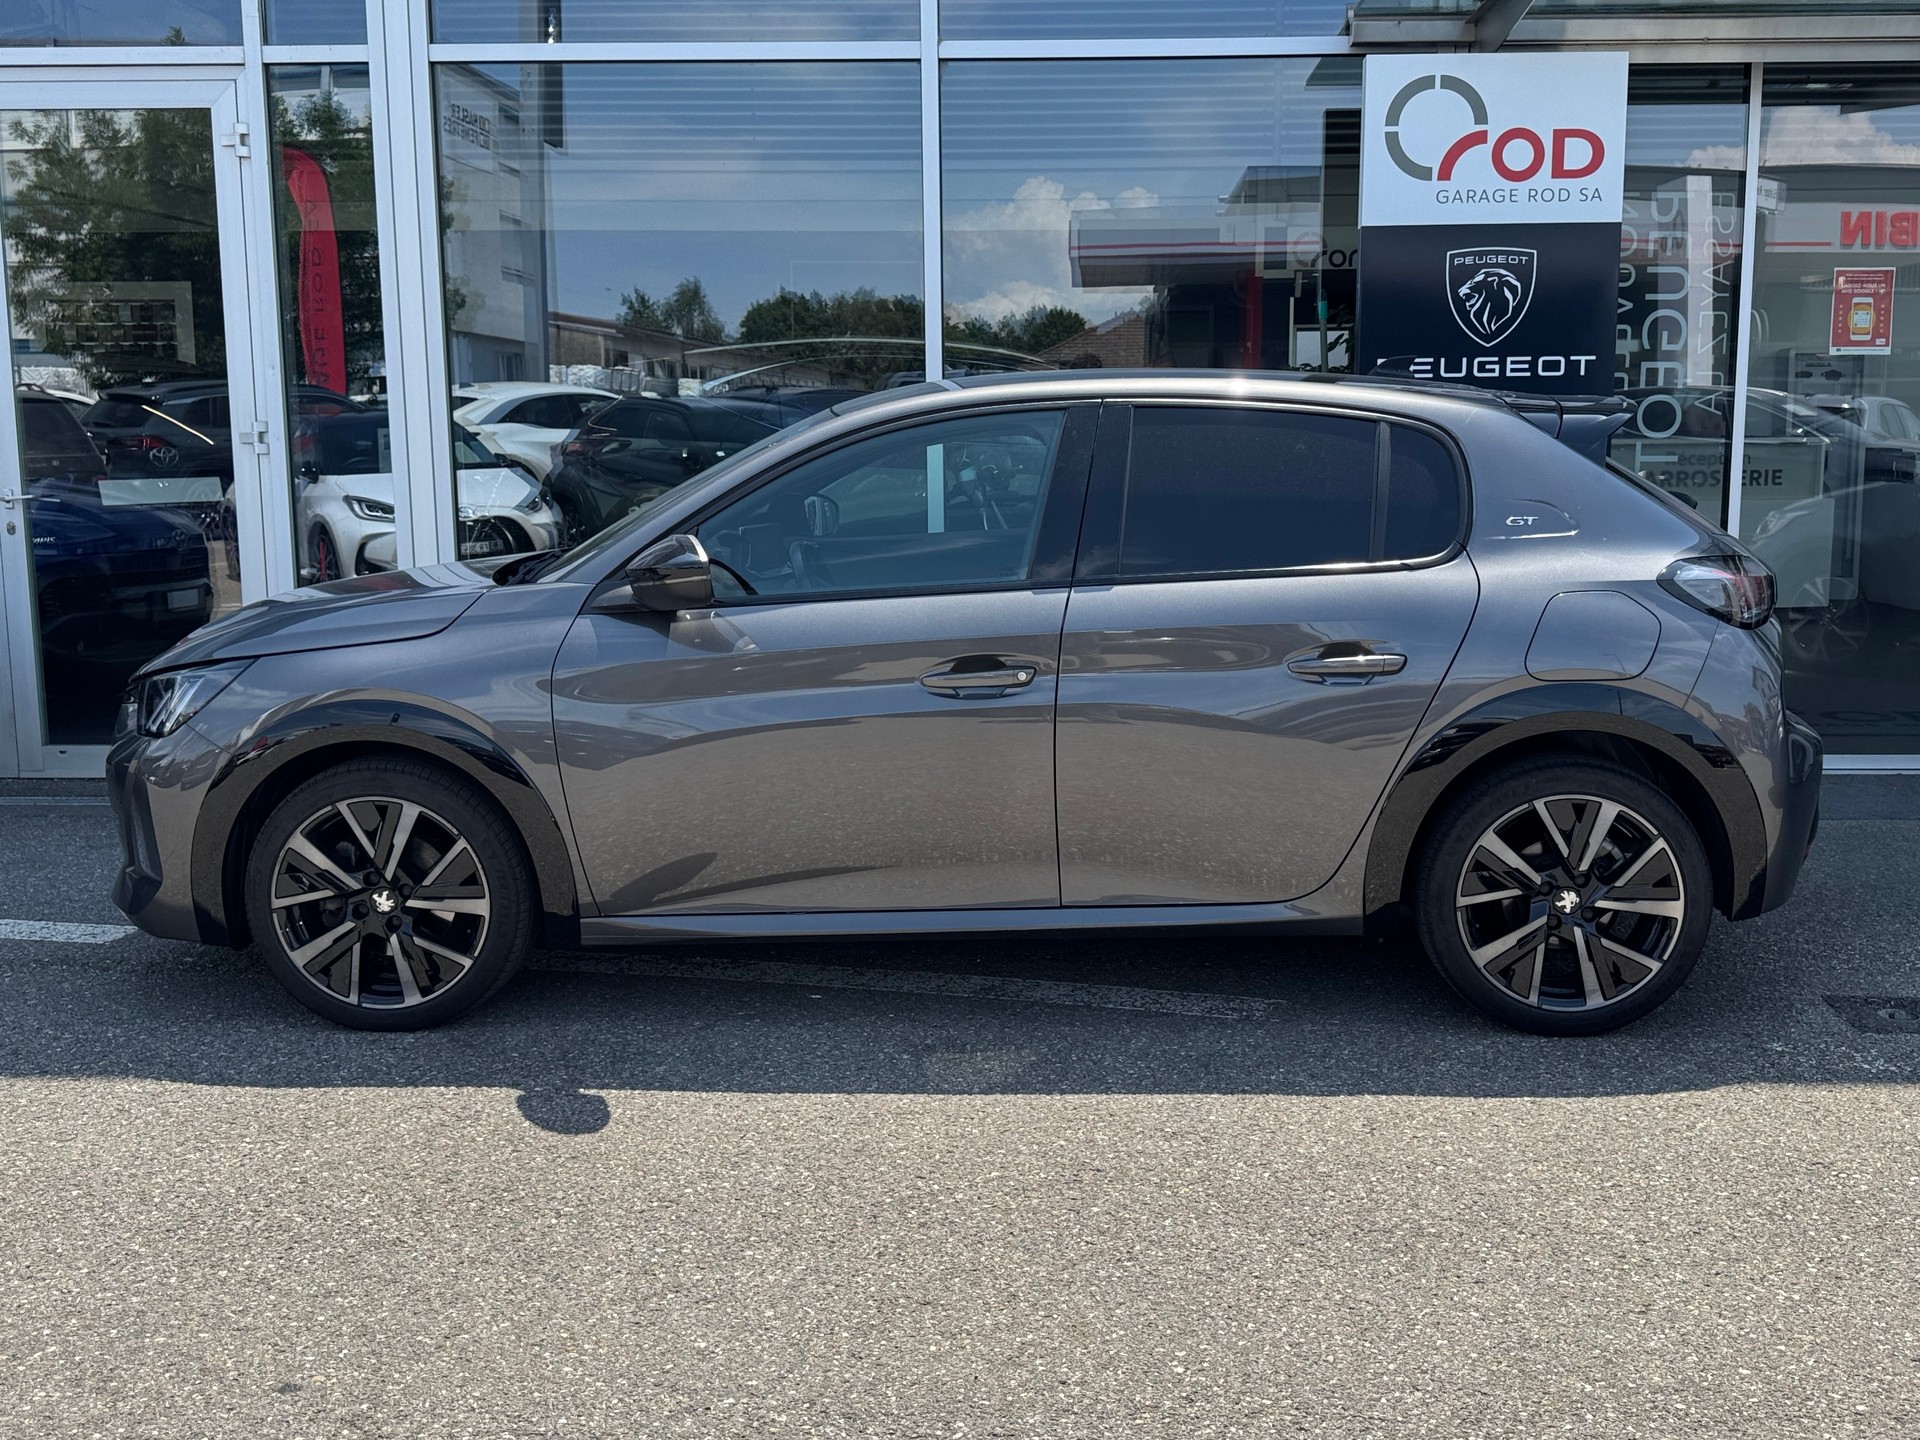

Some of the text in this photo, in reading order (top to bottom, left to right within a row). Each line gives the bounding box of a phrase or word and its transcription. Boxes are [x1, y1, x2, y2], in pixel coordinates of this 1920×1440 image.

[1436, 187, 1603, 205] GARAGE ROD SA
[1454, 255, 1529, 266] PEUGEOT
[1377, 355, 1597, 378] EUGEOT
[1665, 450, 1751, 468] Réceptn
[1645, 469, 1783, 487] ARROSERIE
[1505, 516, 1540, 526] GT
